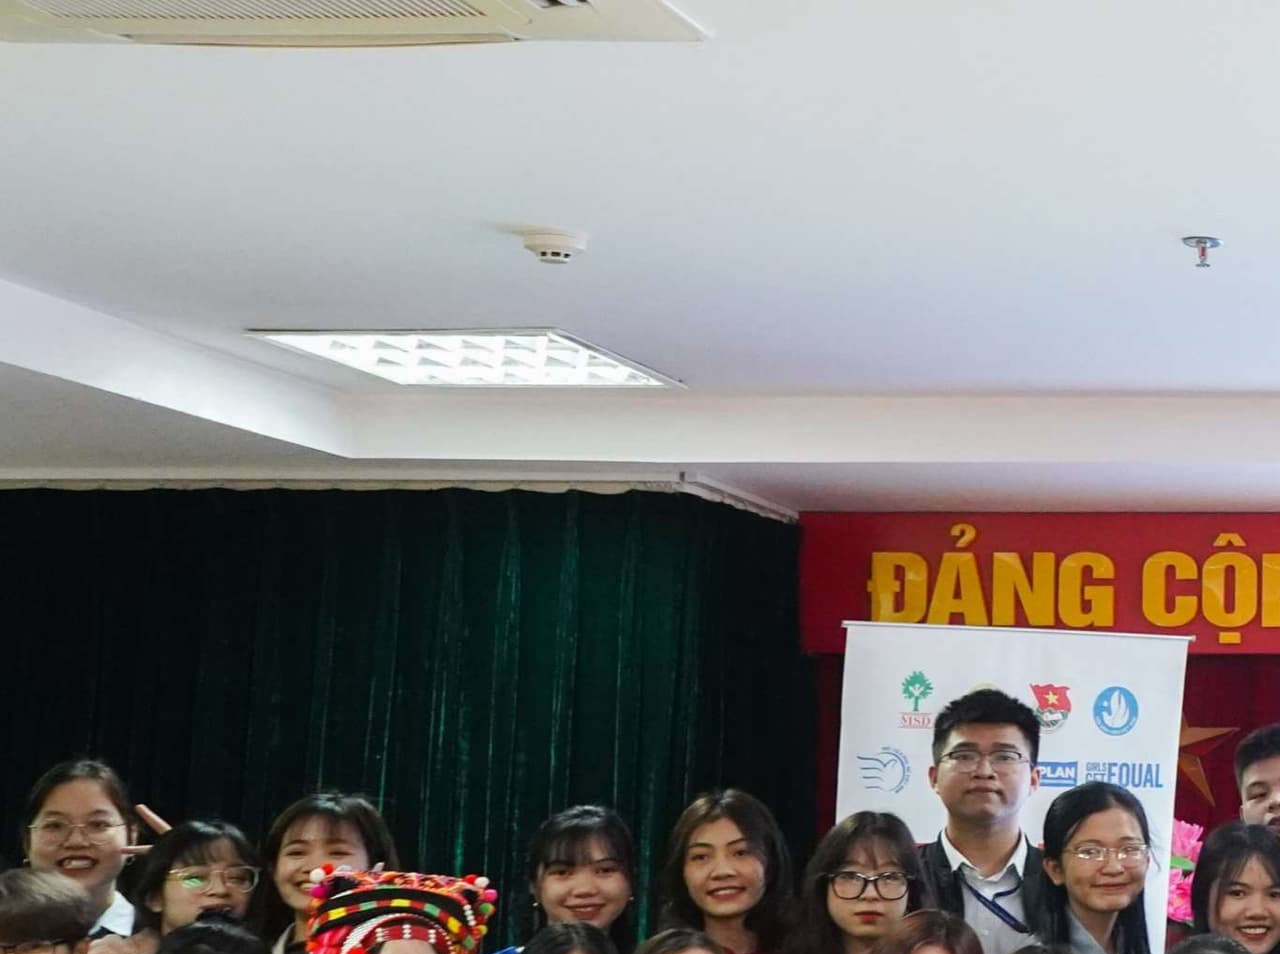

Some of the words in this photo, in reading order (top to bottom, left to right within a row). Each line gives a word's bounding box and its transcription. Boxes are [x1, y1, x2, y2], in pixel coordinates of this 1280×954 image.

[868, 524, 1114, 628] ĐẢNG
[1039, 766, 1076, 778] PLAN
[1107, 762, 1164, 788] EQUAL
